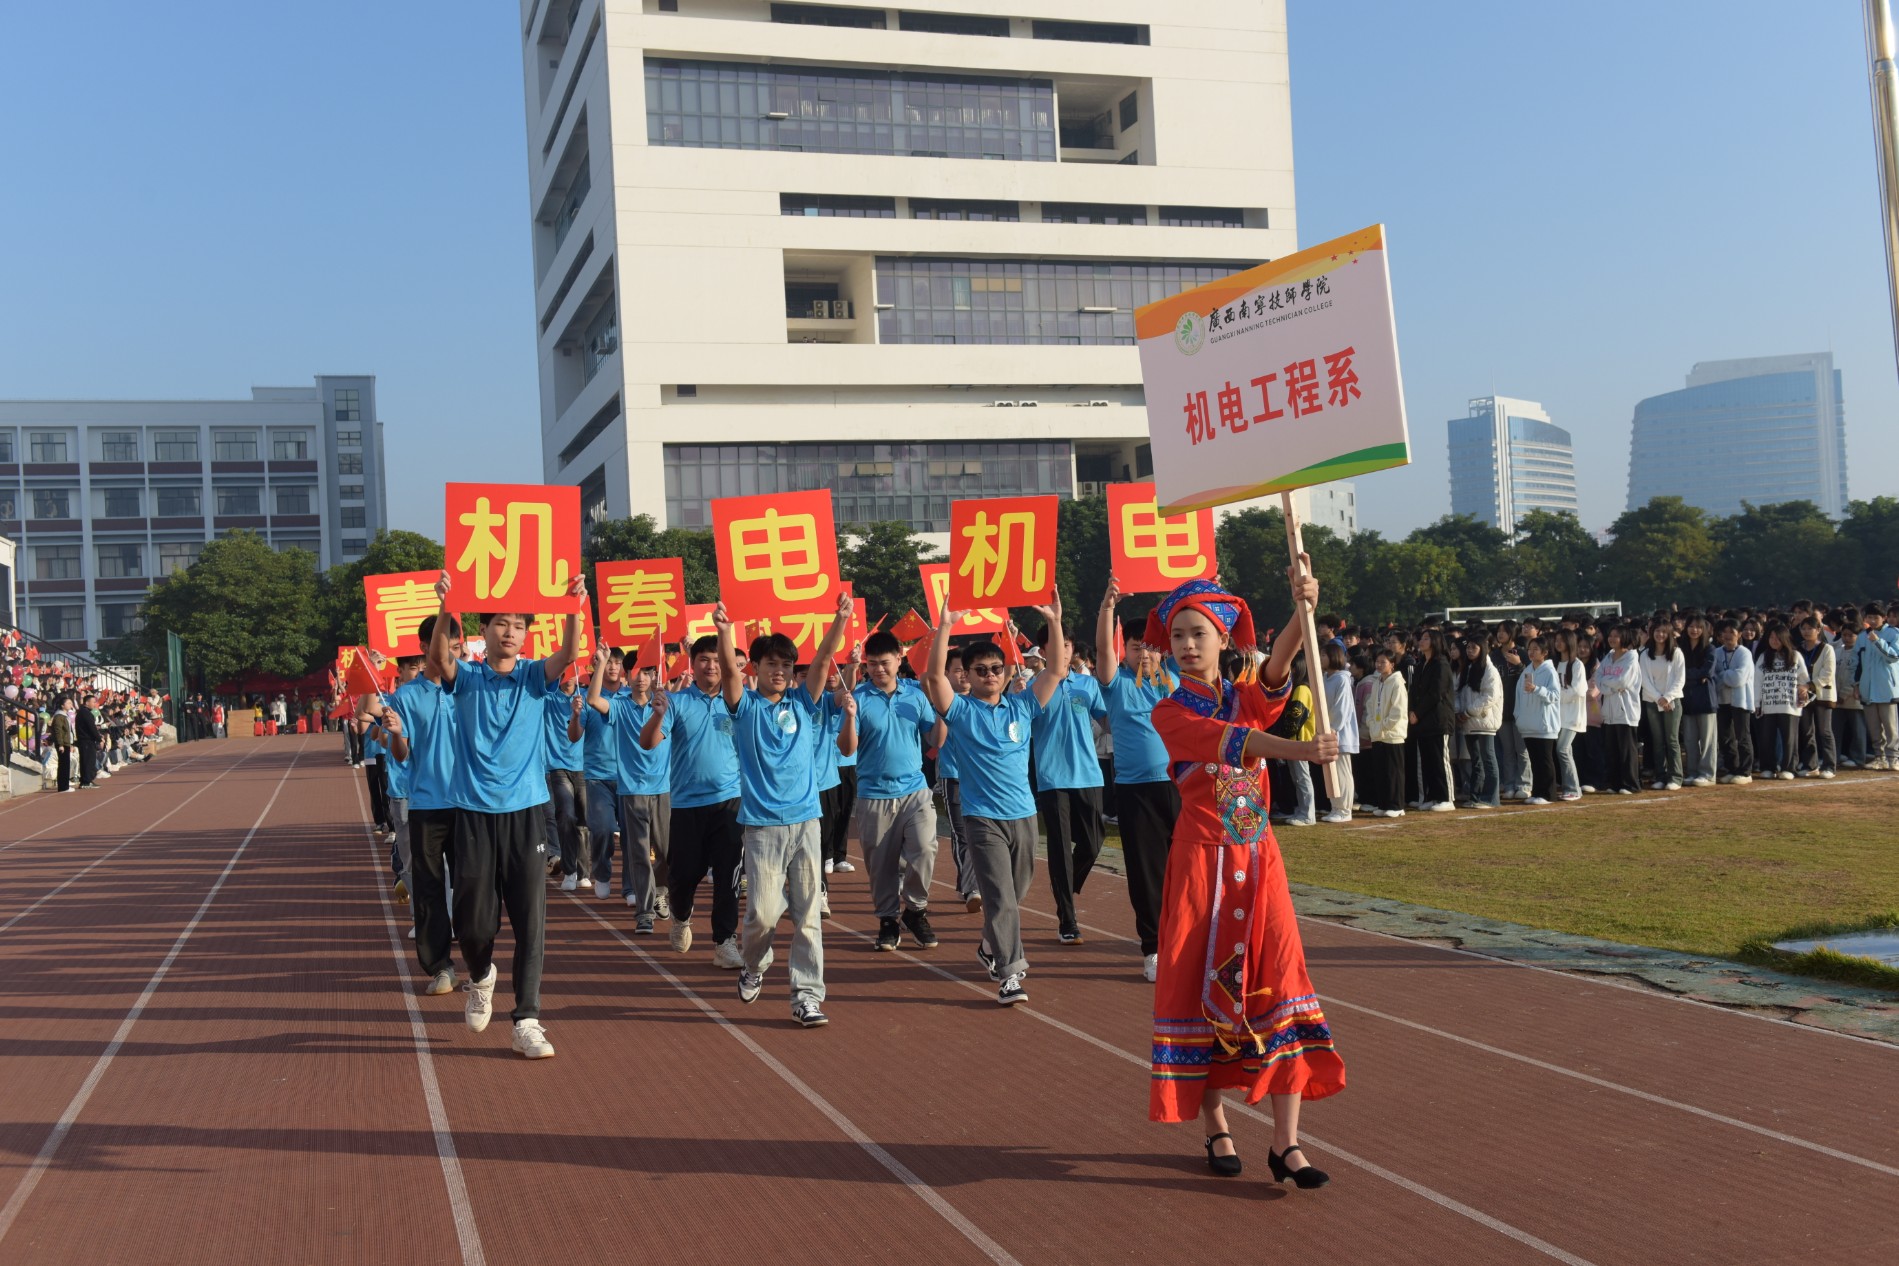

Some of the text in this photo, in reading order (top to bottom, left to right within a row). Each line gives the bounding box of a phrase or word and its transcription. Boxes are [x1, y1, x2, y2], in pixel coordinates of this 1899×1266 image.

[1209, 275, 1331, 332] 廣西南寧技師學院
[1210, 300, 1333, 345] GUANGXI NANNING TECHNICIAN COLLEGE
[1183, 346, 1362, 446] 机电工程系
[456, 497, 568, 600] 机
[729, 508, 830, 602] 电
[958, 510, 1046, 598] 机
[1121, 494, 1207, 579] 电
[606, 569, 679, 637] 春
